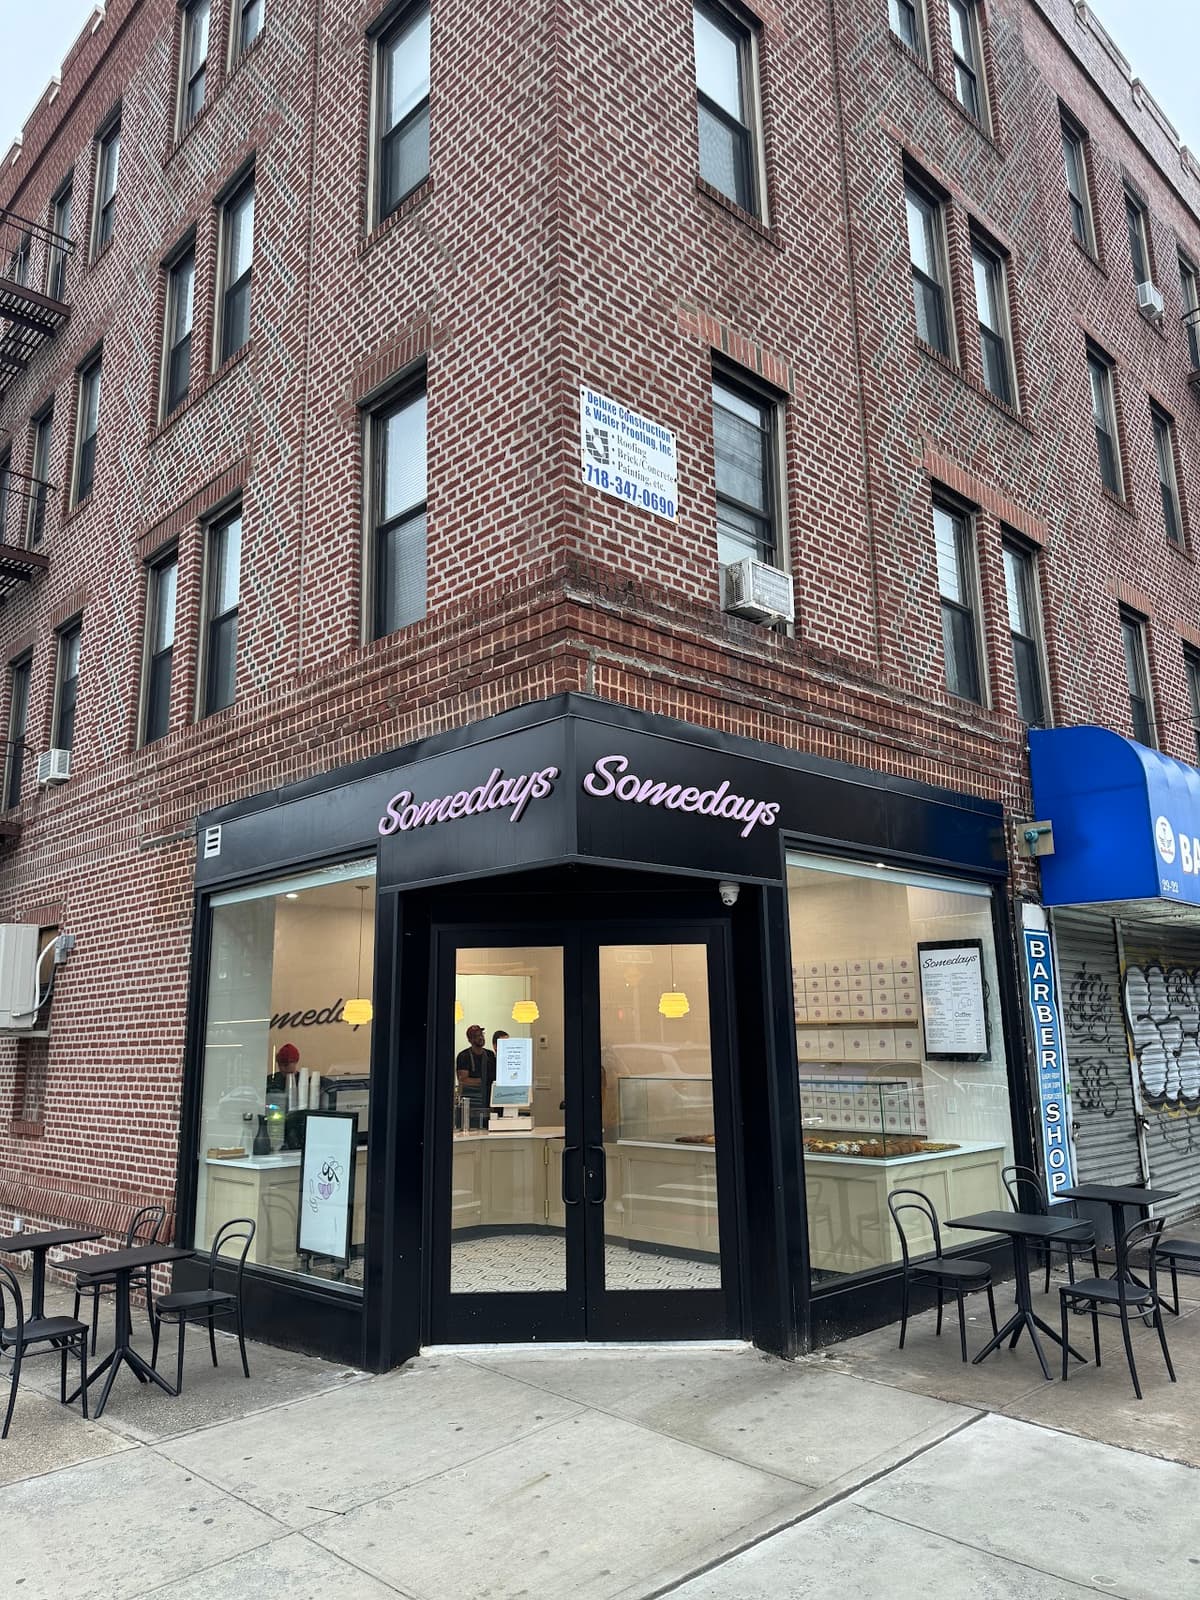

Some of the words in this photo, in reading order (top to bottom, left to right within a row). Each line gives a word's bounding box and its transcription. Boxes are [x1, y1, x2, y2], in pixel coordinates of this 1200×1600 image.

[585, 406, 592, 416] &
[593, 407, 619, 430] Water
[659, 440, 674, 458] Inc.
[587, 391, 617, 416] Deluxe
[618, 407, 671, 443] Construction
[617, 434, 647, 460] Roofing
[617, 448, 673, 482] Brick/Concrete
[586, 464, 674, 518] 718-347-0690
[378, 767, 559, 836] Somedays
[583, 755, 781, 838] Somedays
[922, 954, 978, 969] Somedays
[1029, 940, 1057, 1069] BARBER
[1046, 1103, 1066, 1193] SHOP
